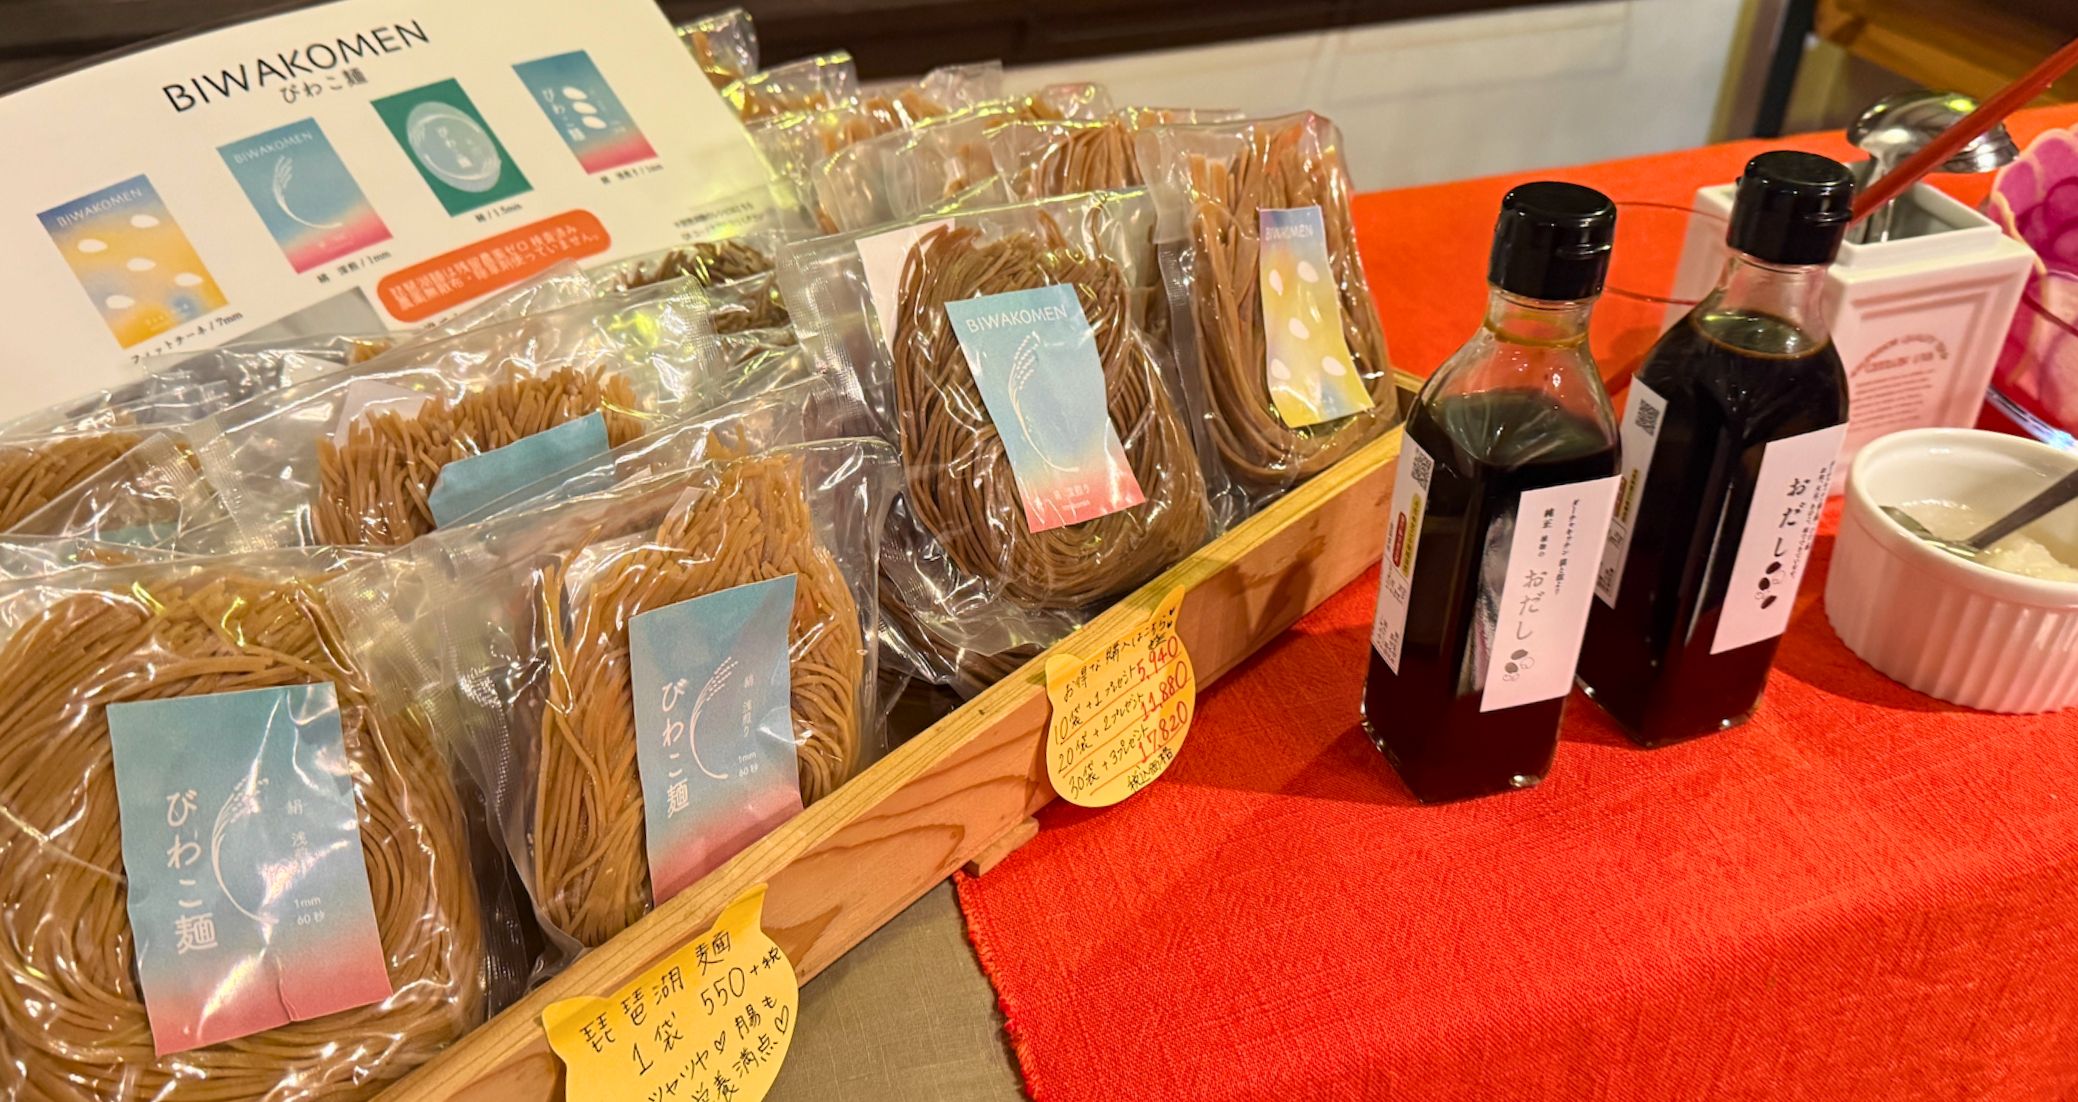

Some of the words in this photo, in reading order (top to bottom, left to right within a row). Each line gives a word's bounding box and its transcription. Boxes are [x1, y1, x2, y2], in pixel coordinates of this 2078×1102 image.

[162, 20, 430, 113] BIWAKOMEN
[280, 67, 368, 104] びわこ麺
[233, 131, 313, 164] BIWAKOMEN
[56, 188, 143, 228] BIWAKOMEN
[215, 311, 244, 327] 7mm
[965, 304, 1068, 334] BIWAKOMEN
[1769, 478, 1811, 558] おだし
[1515, 569, 1549, 640] おだし
[1140, 660, 1188, 722] 11,880
[661, 678, 690, 818] びわこ麺
[738, 751, 757, 763] 1mm
[166, 789, 218, 955] びわこ麺
[294, 896, 322, 909] 1mm
